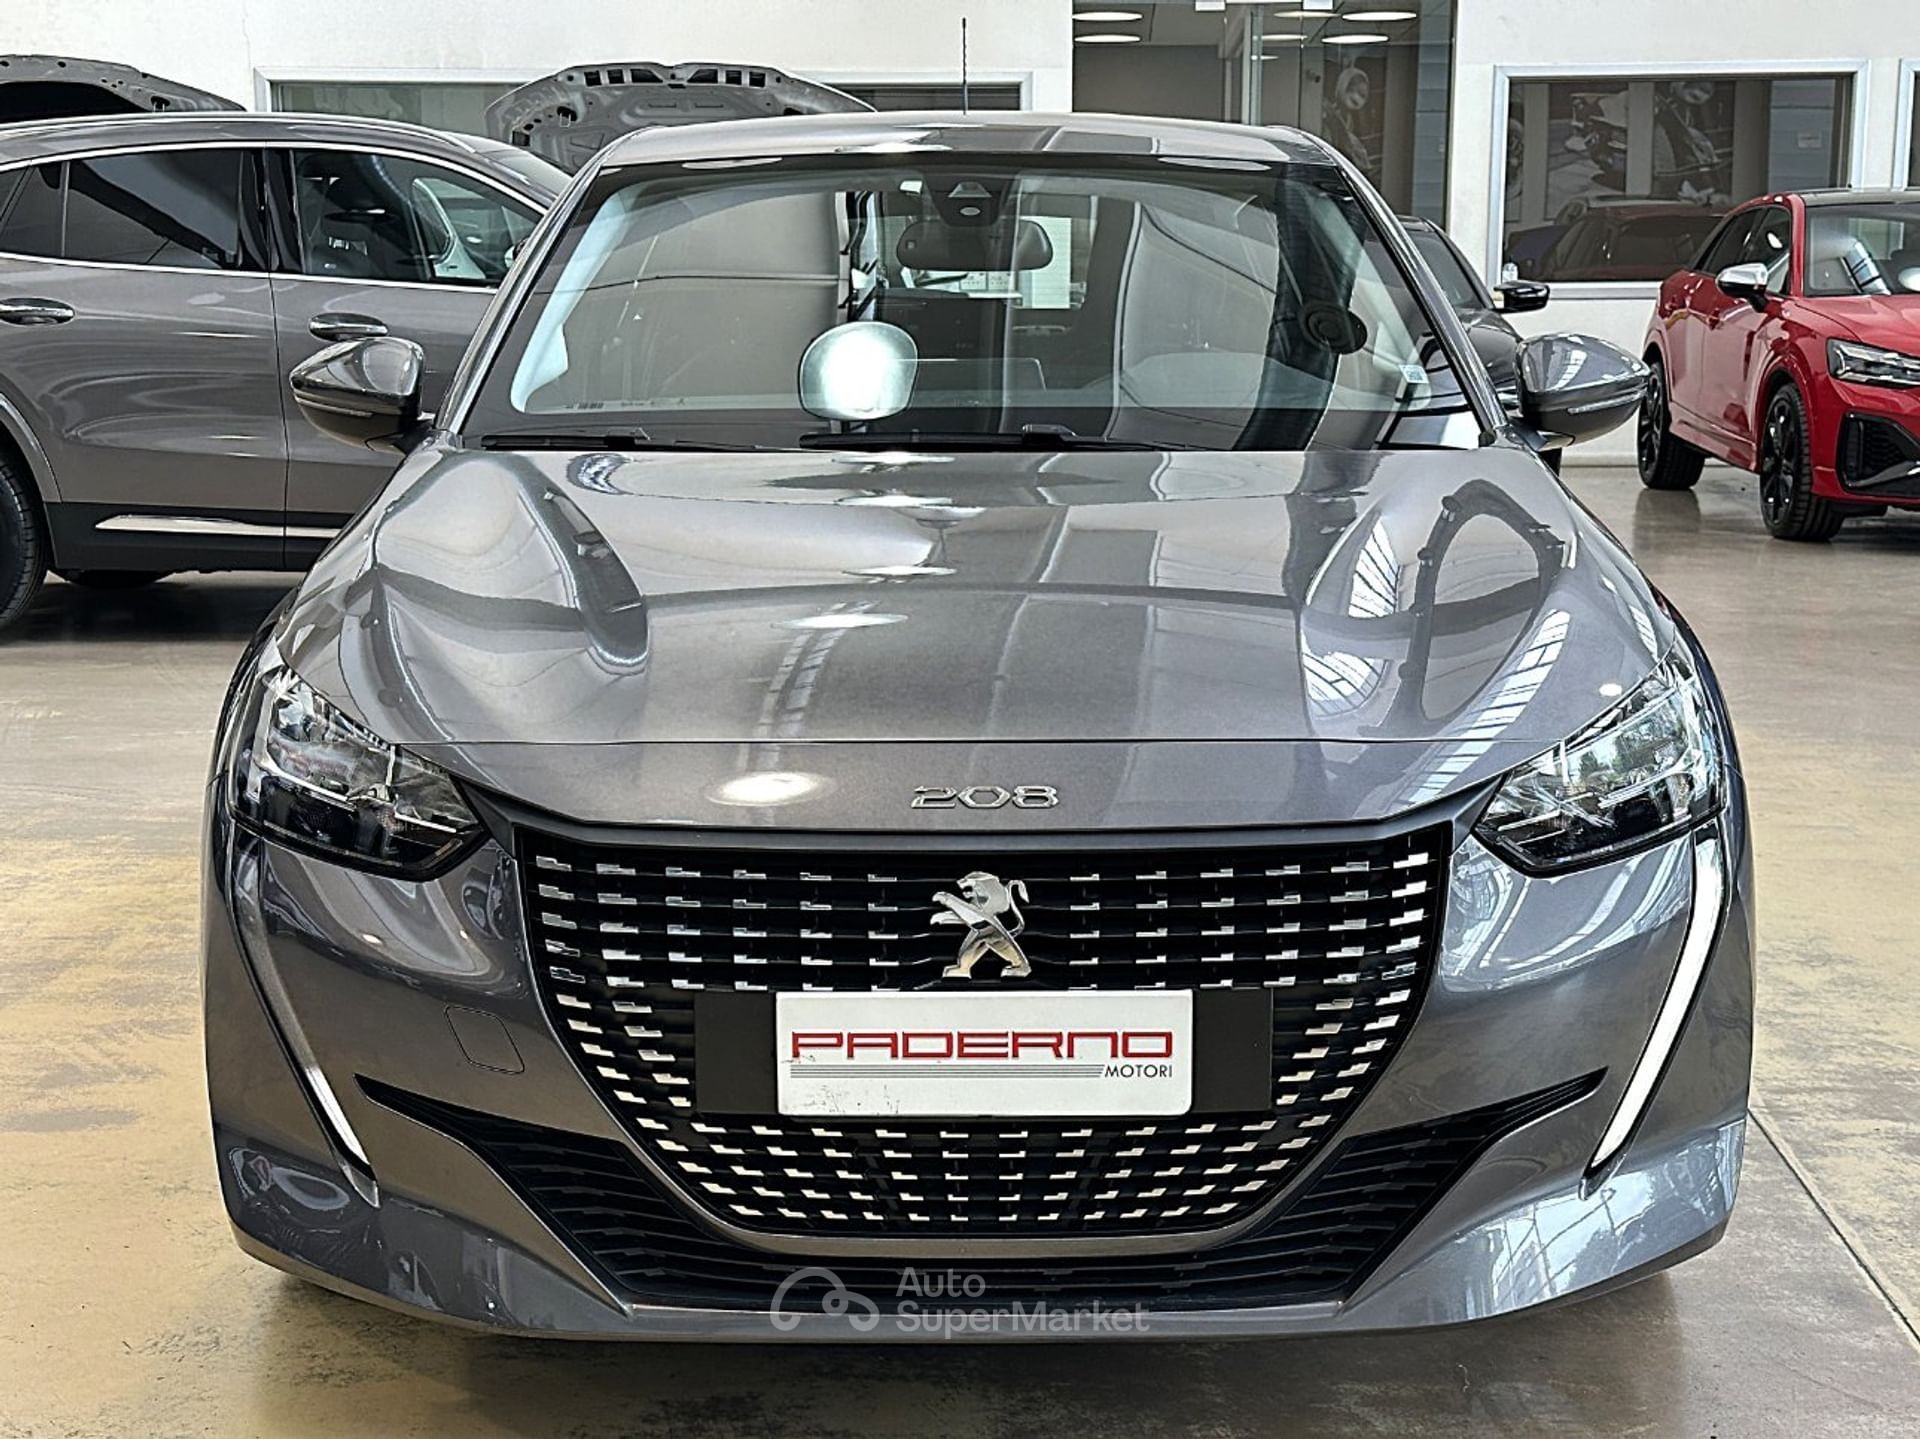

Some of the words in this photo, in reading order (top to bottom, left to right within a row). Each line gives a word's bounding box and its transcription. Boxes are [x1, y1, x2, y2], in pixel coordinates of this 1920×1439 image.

[911, 784, 1060, 809] 208
[791, 1031, 1173, 1059] PADERNO
[1104, 1064, 1173, 1079] MOTORI
